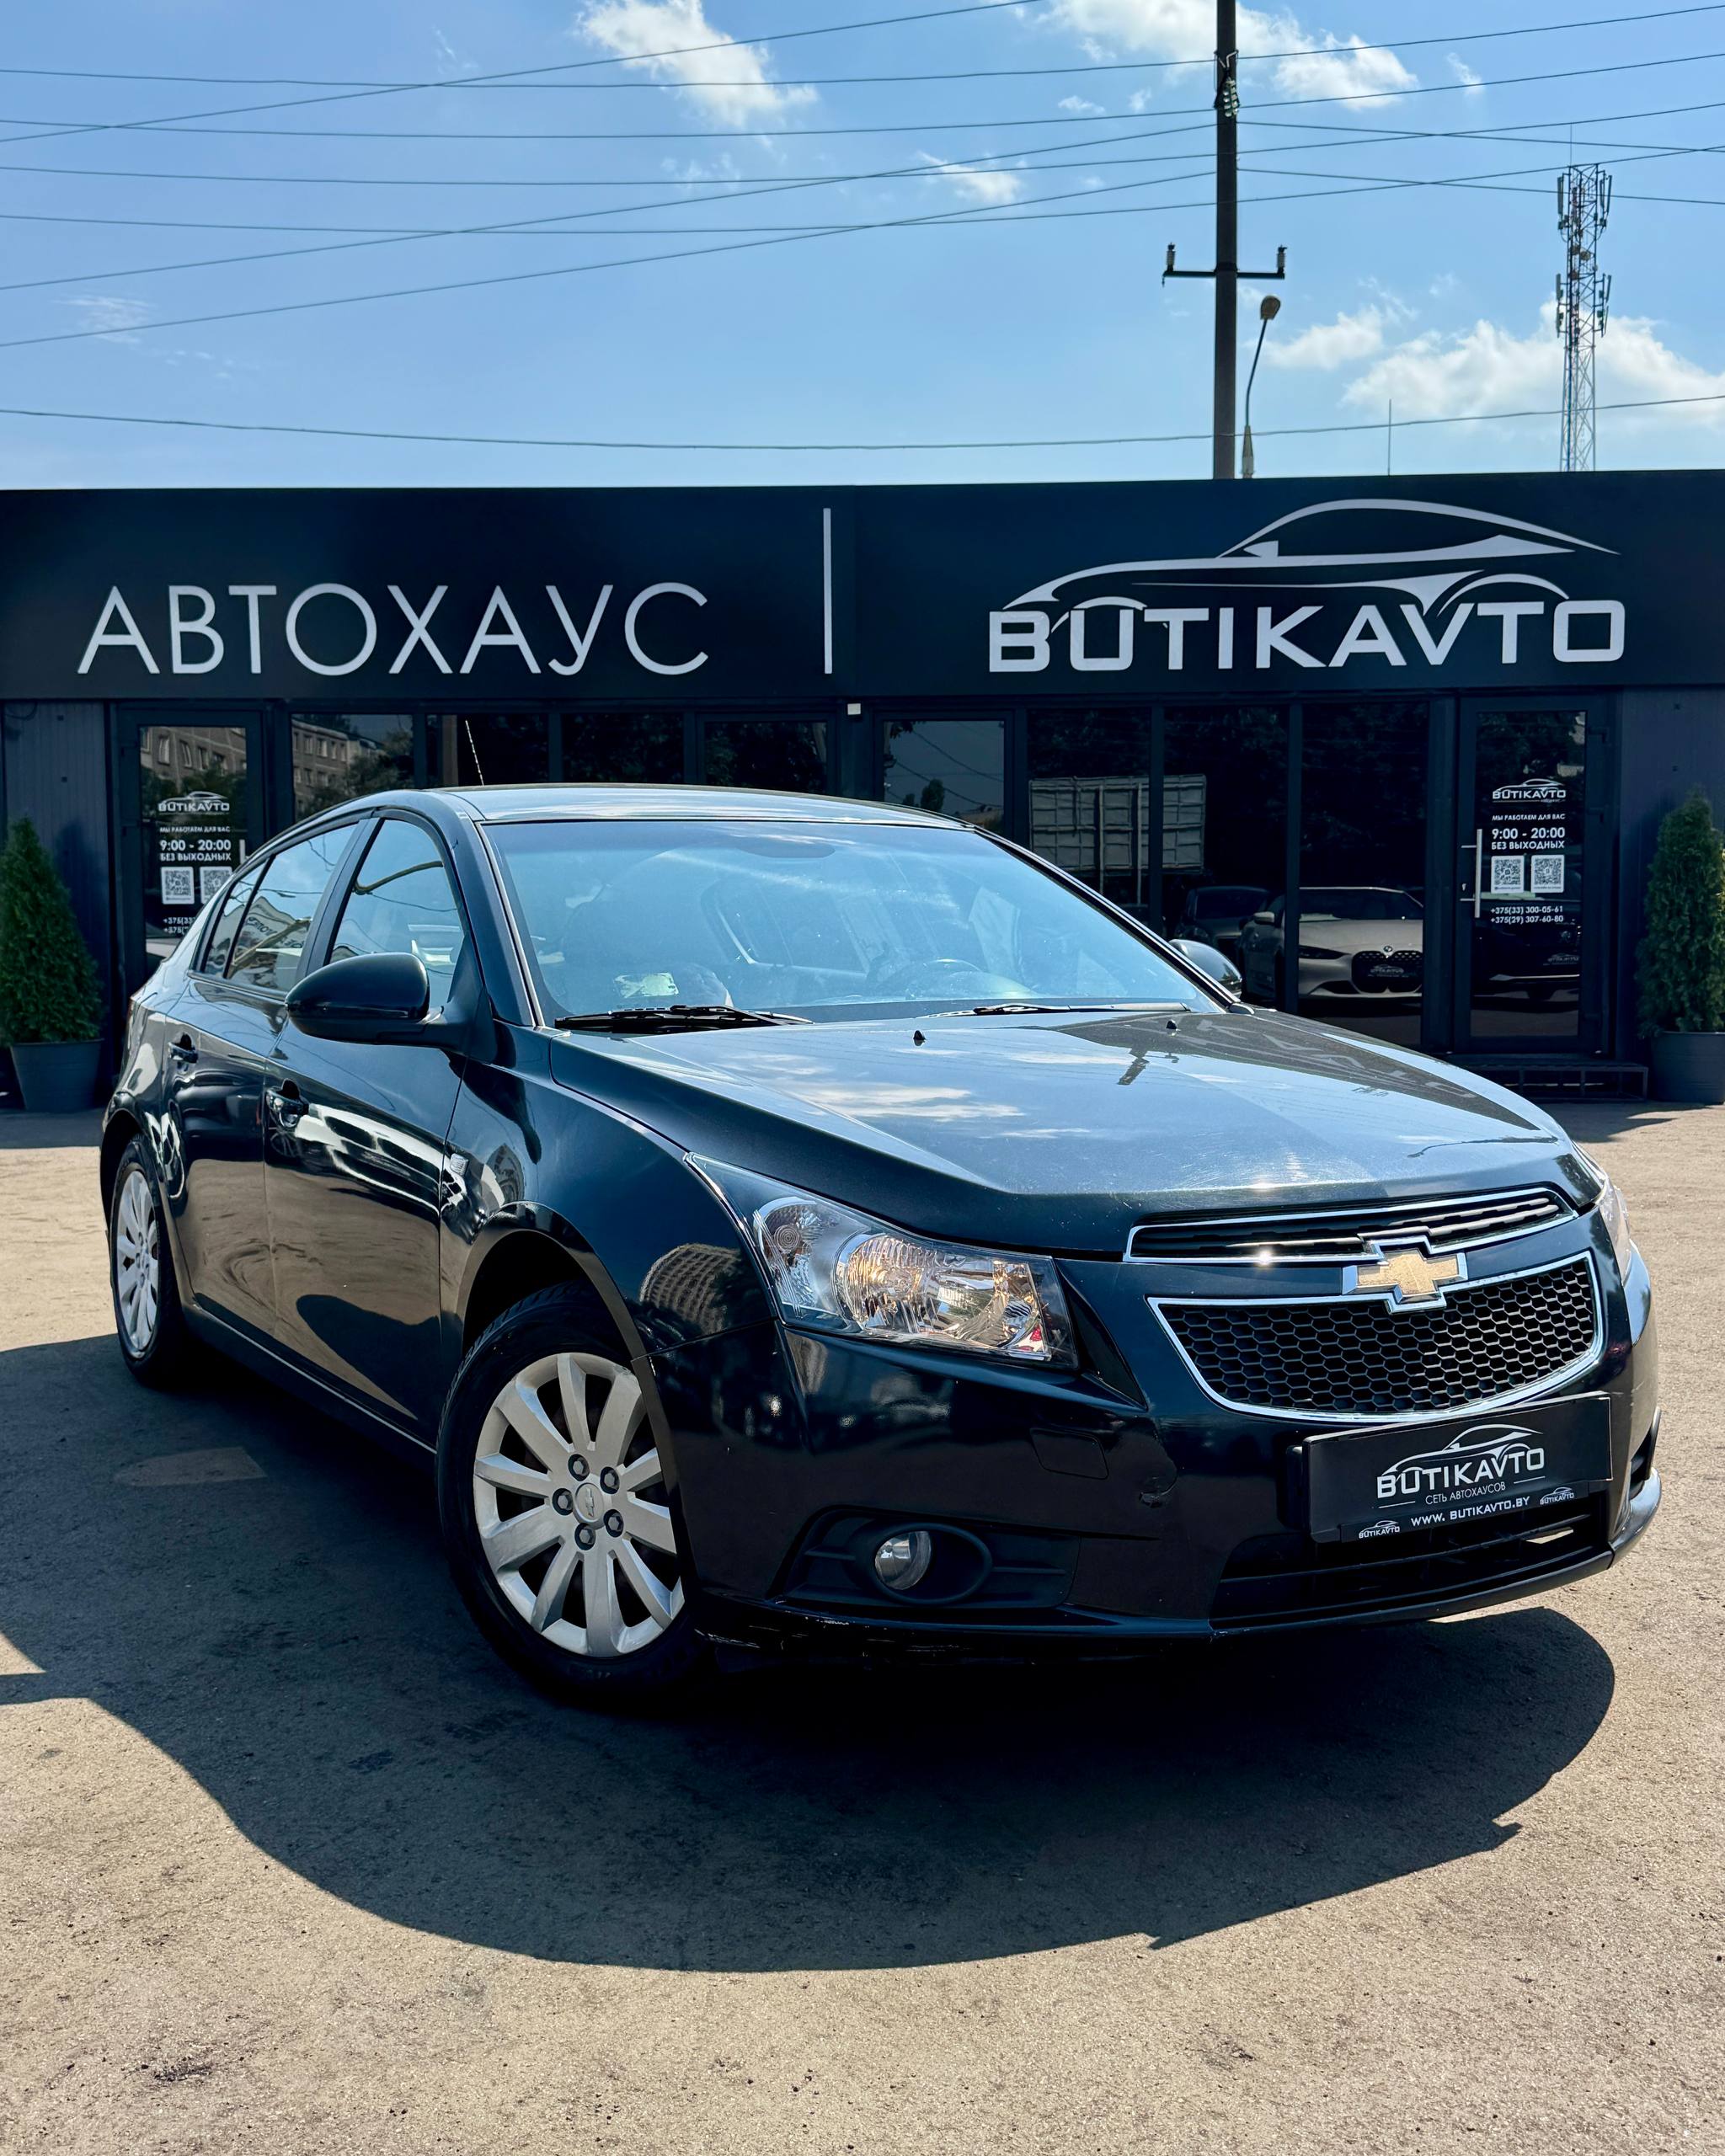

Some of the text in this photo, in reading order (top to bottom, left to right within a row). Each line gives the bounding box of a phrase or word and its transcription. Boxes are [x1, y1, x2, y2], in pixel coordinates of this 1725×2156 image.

[77, 582, 709, 676] АВТОХАУС
[988, 600, 1626, 672] BUTIKAVTO
[1492, 790, 1566, 799] BUTIKAVTO
[158, 801, 230, 812] BUTIKAVTO
[1492, 828, 1519, 840] 9:00
[1530, 827, 1566, 839] 20:00
[160, 839, 186, 851] 9:00
[197, 839, 232, 851] 20:00
[1492, 841, 1565, 851] БЕЗ ВЫХОДНЫХ
[160, 852, 232, 862] БЕЗ ВЫХОДНЫХ
[1491, 905, 1563, 915] +375(33) 300-05-61
[1491, 915, 1564, 925] +375(29) 307-60-80
[1377, 1448, 1545, 1498] BUTIKAVTO
[1425, 1481, 1506, 1505] СЕТЬ АВТОХАУСОВ
[1540, 1492, 1574, 1505] BUTIKAVTO
[1411, 1496, 1530, 1527] WWW. BUTIKAVTO.BY
[1359, 1526, 1400, 1539] BUTIKAVTO
